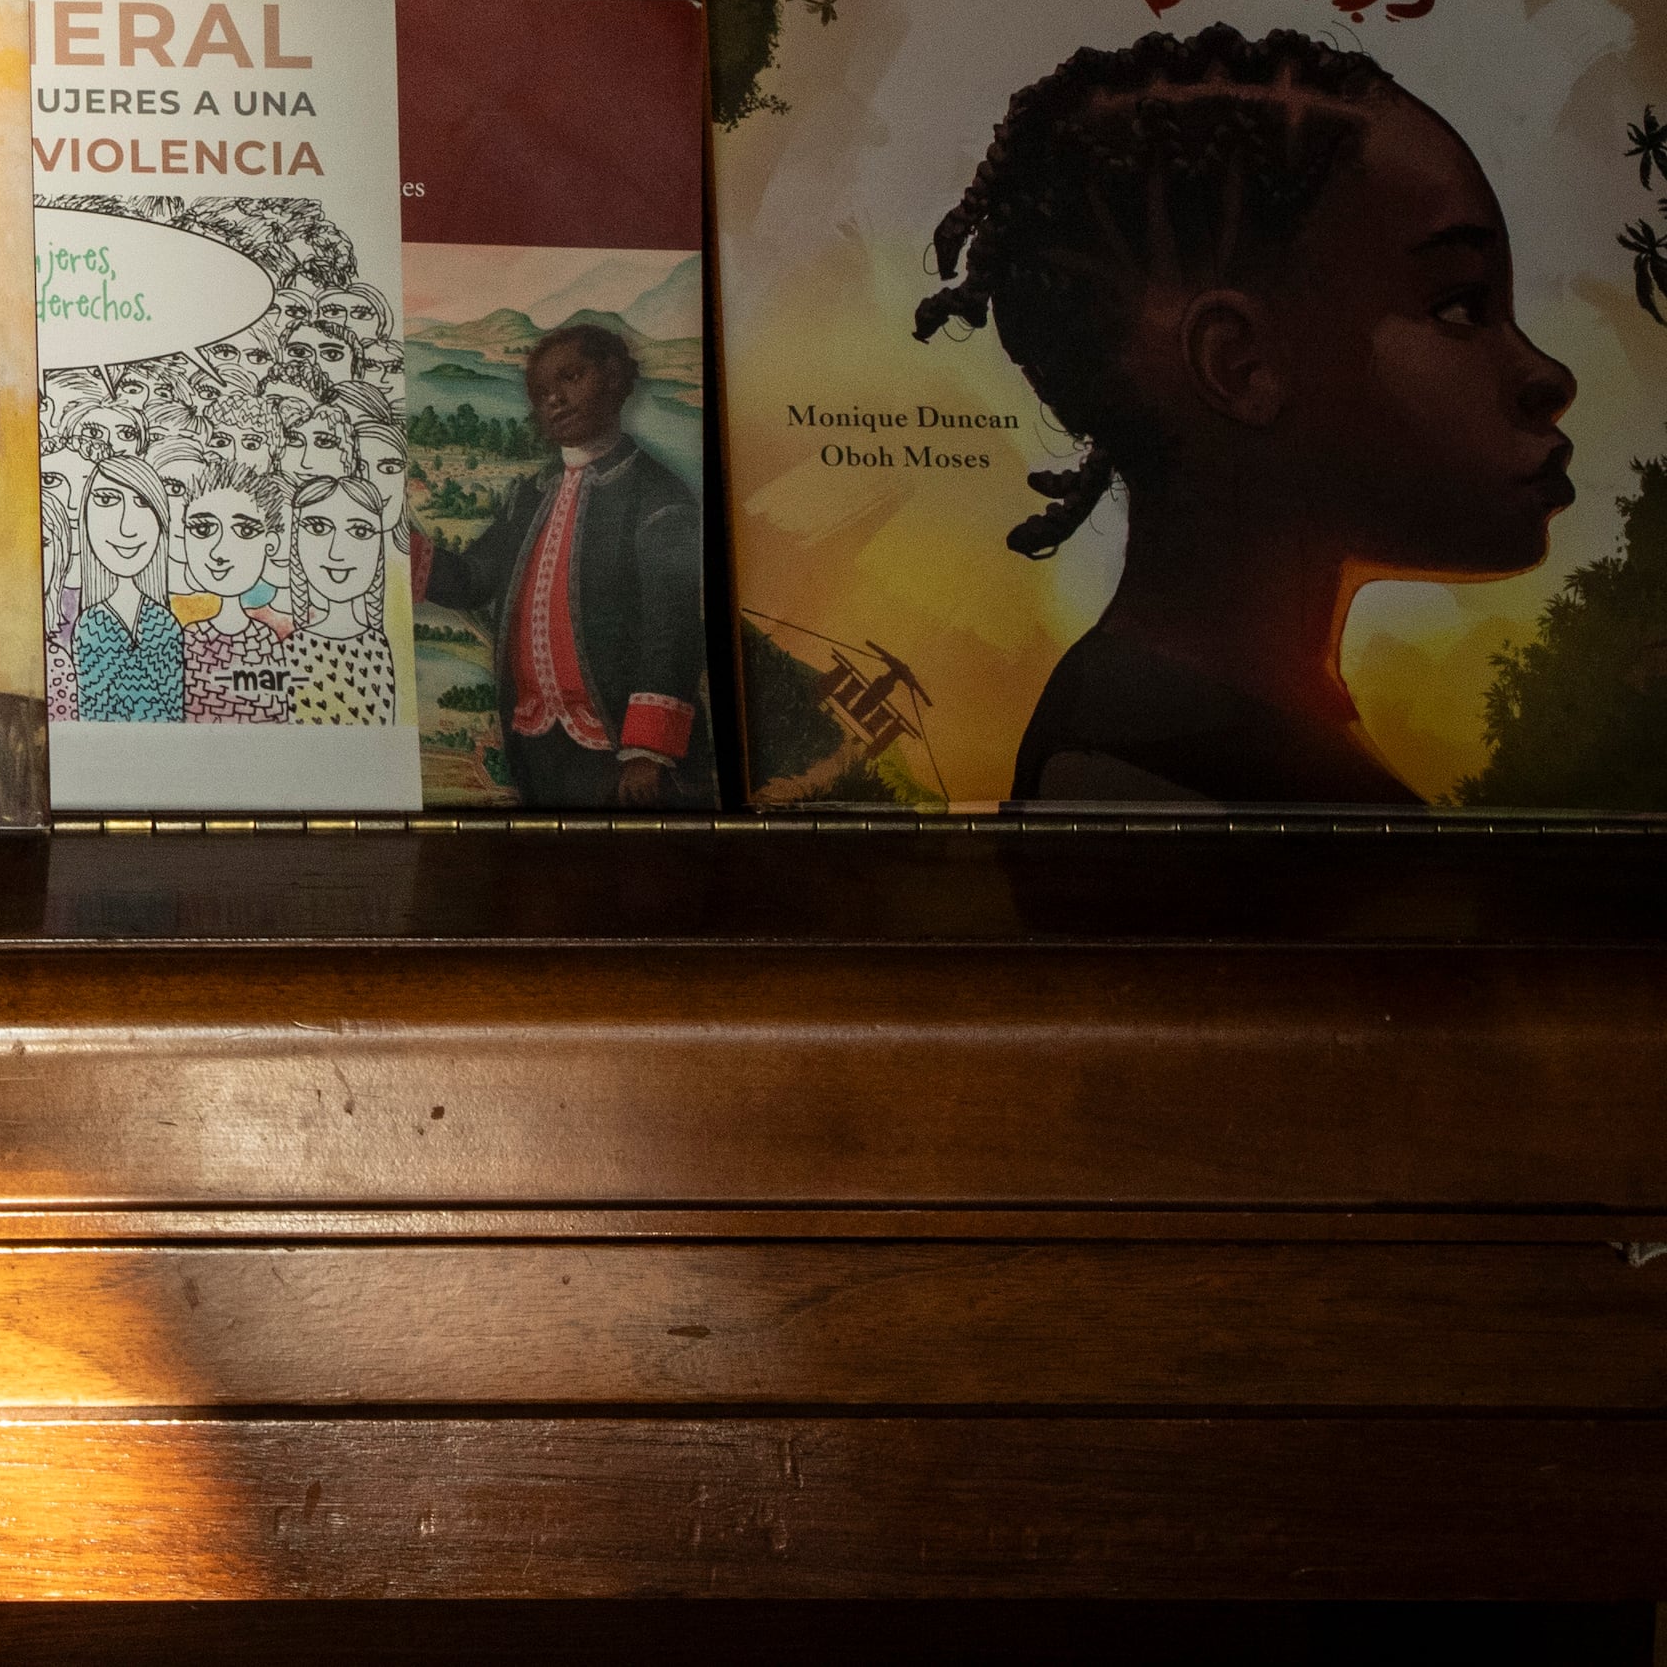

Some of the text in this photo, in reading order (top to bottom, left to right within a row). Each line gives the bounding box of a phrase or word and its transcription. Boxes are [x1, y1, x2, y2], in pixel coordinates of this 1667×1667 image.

[29, 0, 312, 70] ERAL
[194, 91, 219, 116] A
[234, 91, 317, 117] UNA
[31, 137, 324, 176] VIOLENCIA
[787, 405, 1019, 432] Monique Duncan
[821, 444, 990, 468] Oboh Moses
